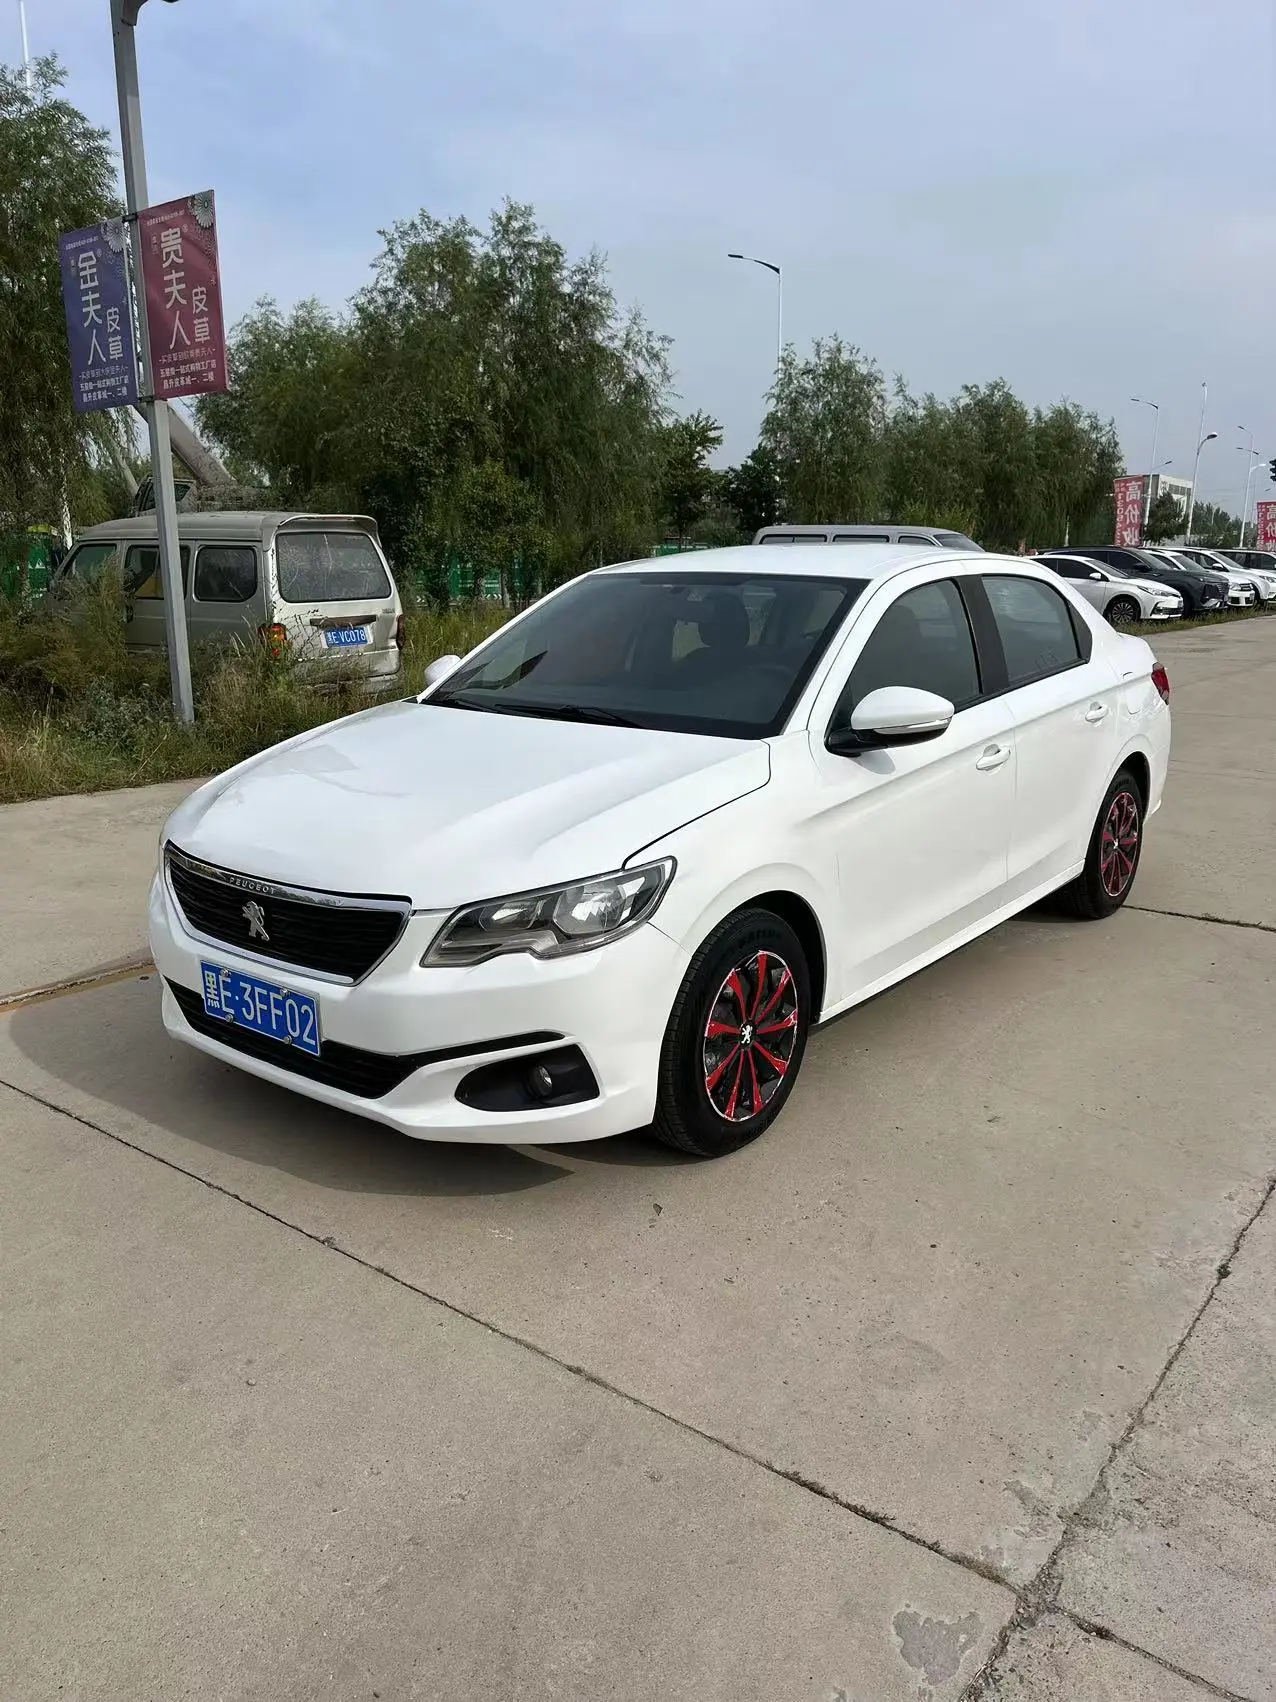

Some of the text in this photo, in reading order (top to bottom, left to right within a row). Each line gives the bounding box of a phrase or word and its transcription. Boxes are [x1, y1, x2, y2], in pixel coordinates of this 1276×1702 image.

[78, 251, 106, 365] 金夫人
[160, 228, 191, 350] 贵夫人
[192, 286, 211, 343] 皮草
[106, 306, 123, 360] 皮草
[230, 877, 275, 895] PEUGEOT
[204, 970, 316, 1046] 黑E·3FF02
